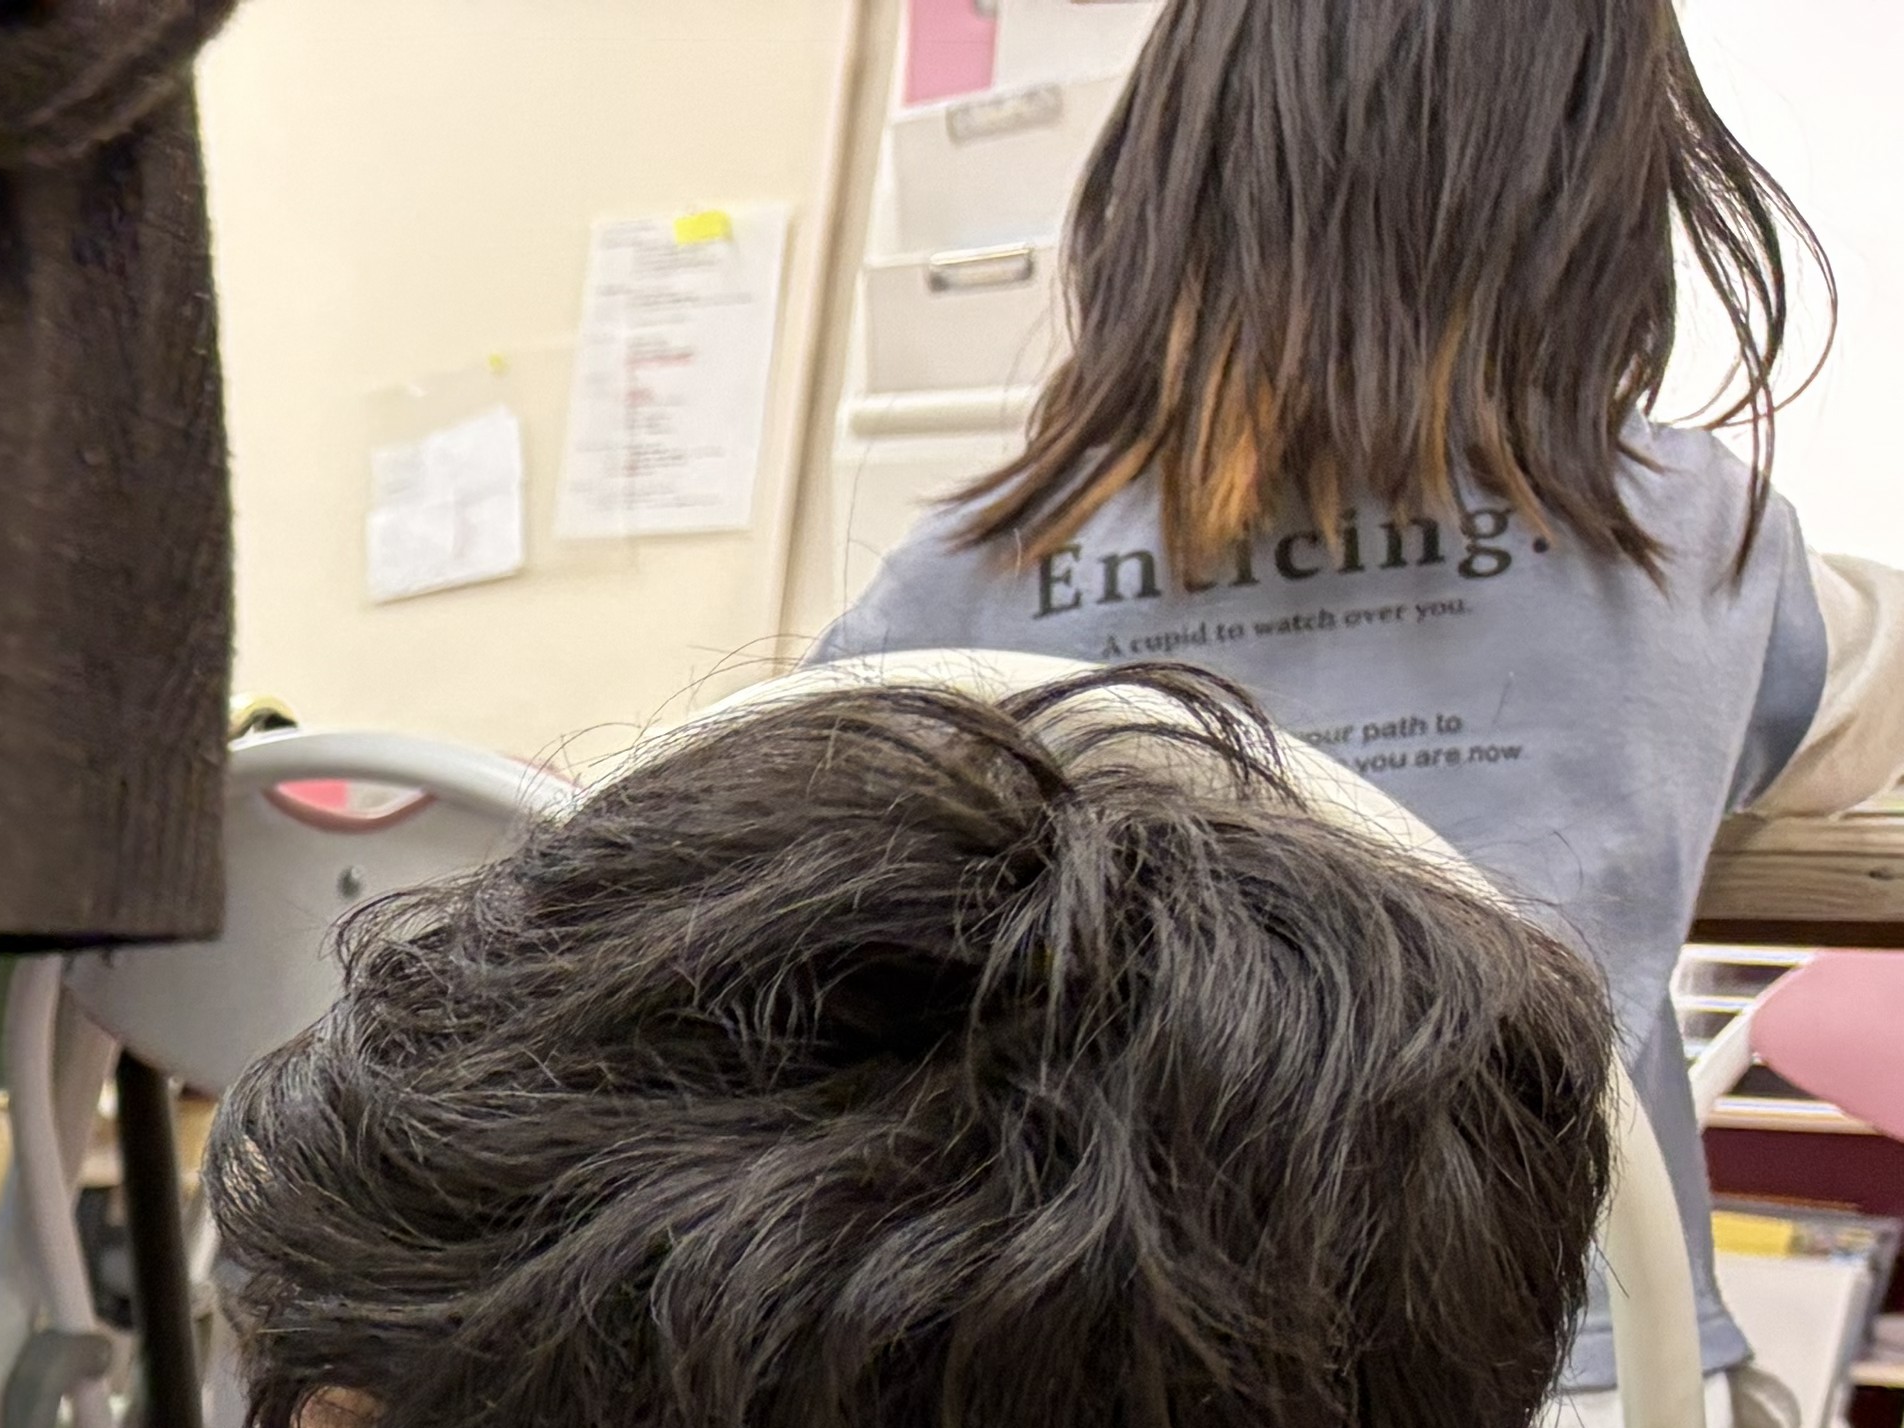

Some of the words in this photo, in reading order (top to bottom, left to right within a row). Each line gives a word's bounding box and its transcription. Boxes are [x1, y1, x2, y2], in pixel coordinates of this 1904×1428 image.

[1101, 633, 1123, 658] A
[1130, 622, 1207, 657] cupid
[1217, 621, 1244, 643] to
[1253, 608, 1336, 639] watch
[1344, 601, 1405, 627] over
[1362, 715, 1429, 743] path
[1435, 713, 1464, 735] to
[1354, 751, 1407, 774] you
[1414, 746, 1460, 768] are
[1467, 743, 1524, 763] now
